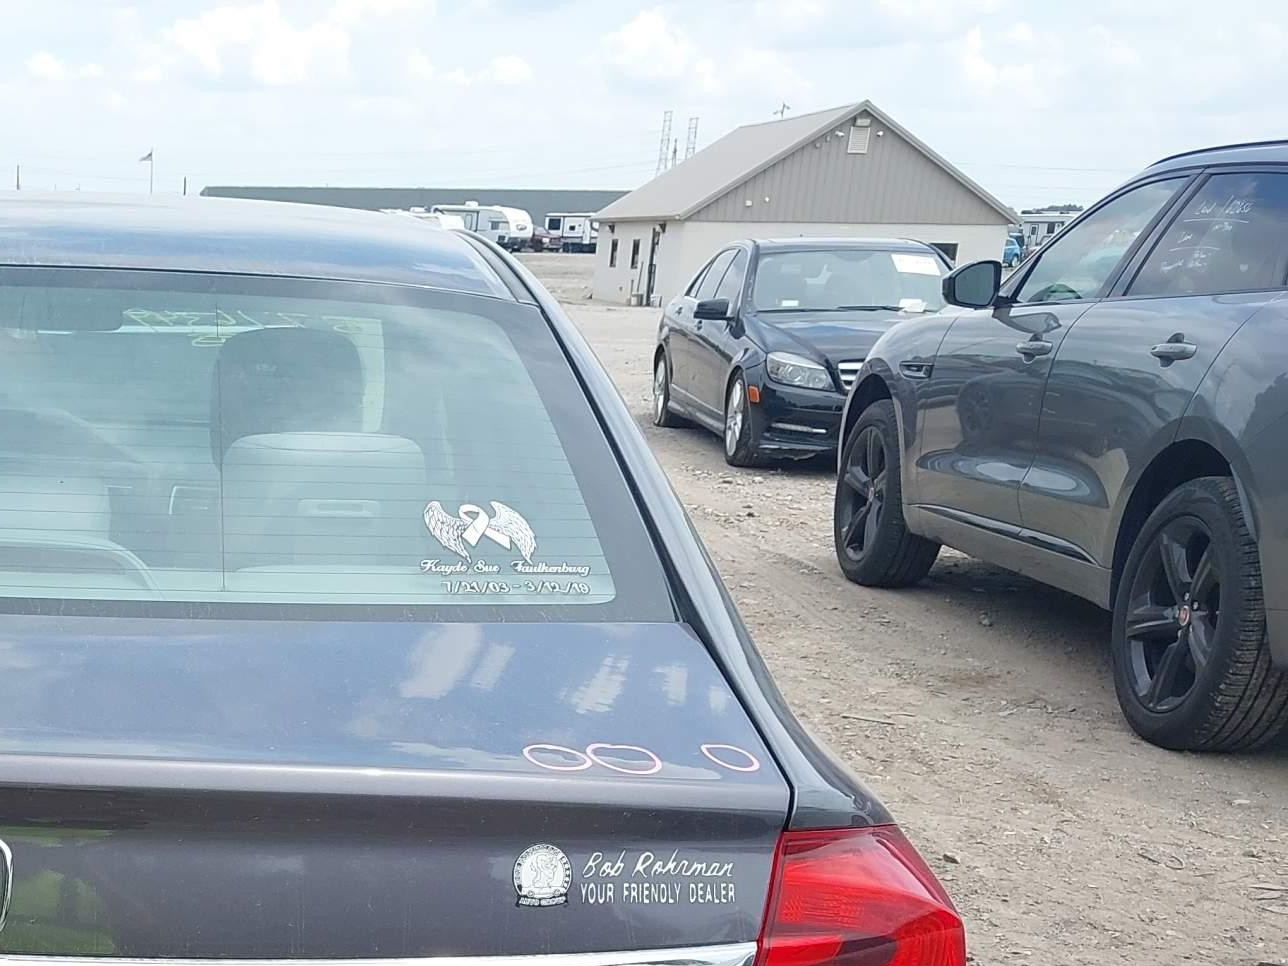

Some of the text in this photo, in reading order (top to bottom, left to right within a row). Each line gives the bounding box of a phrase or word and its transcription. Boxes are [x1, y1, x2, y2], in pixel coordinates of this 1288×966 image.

[582, 848, 626, 878] Bob
[632, 848, 735, 878] Rohrman
[580, 882, 736, 904] YOUR FRIENDLY DEALER
